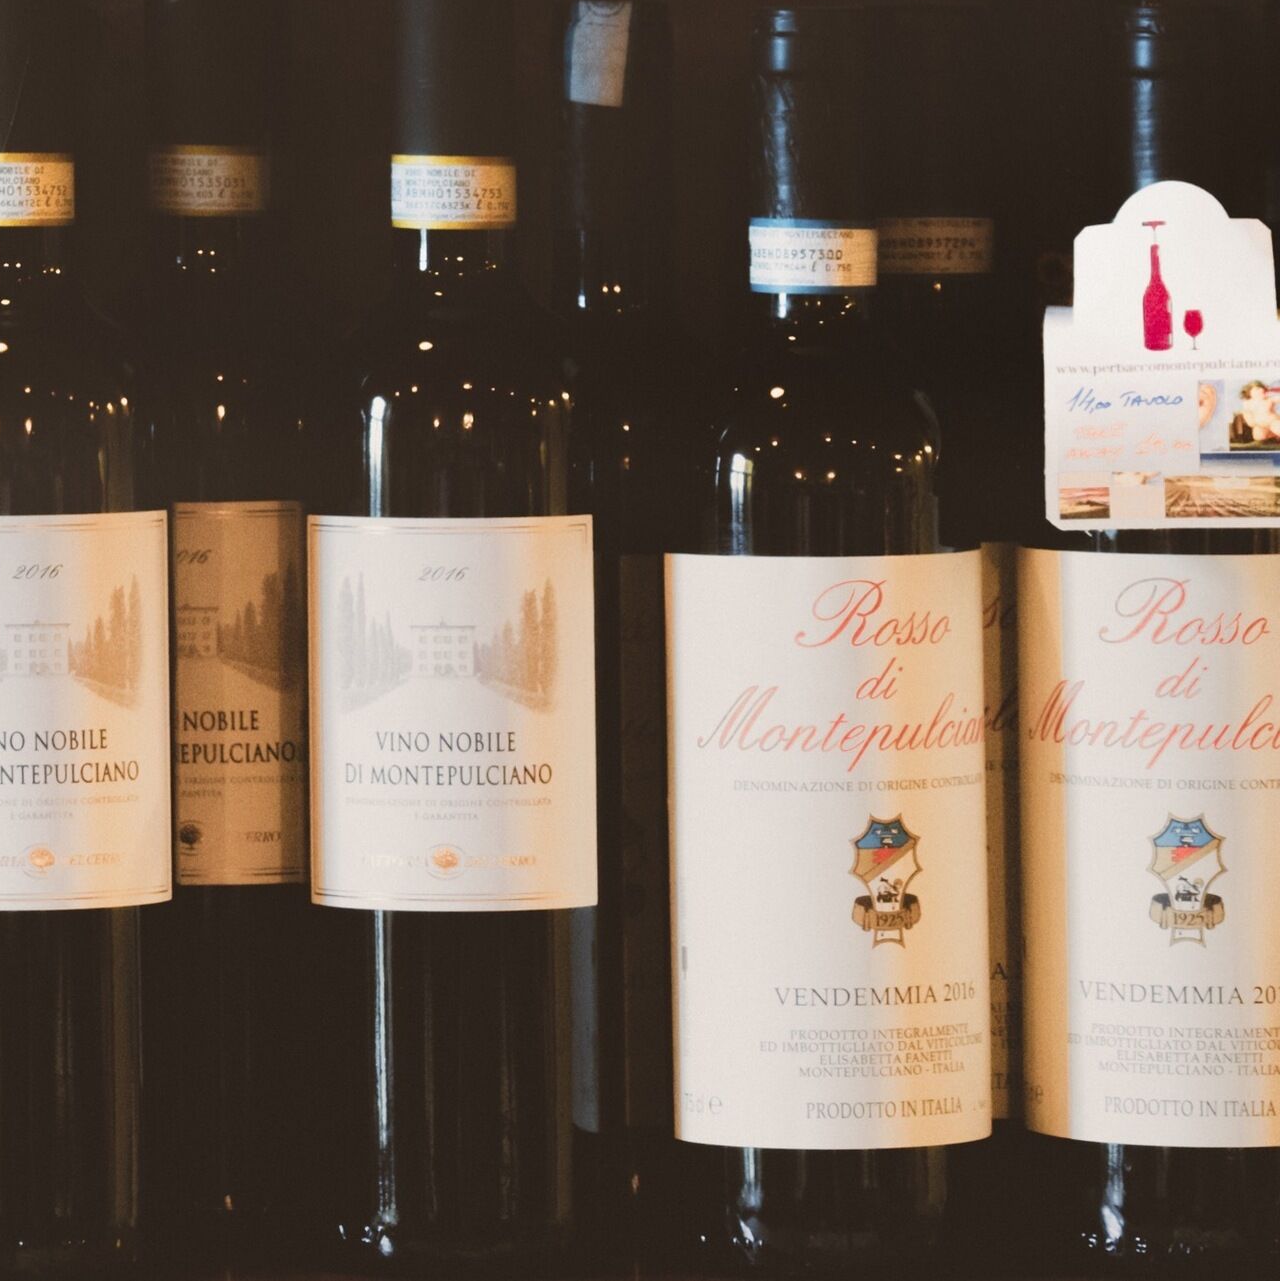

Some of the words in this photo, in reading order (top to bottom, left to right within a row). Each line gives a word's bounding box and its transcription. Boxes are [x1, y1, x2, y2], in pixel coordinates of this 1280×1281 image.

[12, 564, 64, 581] 2016
[417, 566, 470, 582] 2016
[794, 578, 952, 648] Rosso
[1098, 576, 1270, 646] Rosso
[855, 656, 904, 701] di
[1155, 655, 1208, 700] di
[182, 709, 260, 732] NOBILE
[34, 729, 109, 751] NOBILE
[375, 731, 430, 753] VINO
[438, 730, 517, 753] NOBILE
[344, 762, 364, 784] DI
[369, 762, 553, 786] MONTEPULCIANO
[1049, 772, 1154, 790] DENOMINAZIONE
[1156, 777, 1173, 790] DI
[1175, 778, 1236, 791] ORIGINE
[733, 779, 854, 793] DENOMINAZIONE
[858, 781, 873, 792] DI
[876, 778, 929, 791] ORIGINE
[773, 984, 938, 1007] VENDEMMIA
[943, 981, 976, 1003] 2016
[1079, 979, 1244, 1005] VENDEMMIA
[790, 1027, 869, 1041] PRODOTTO
[872, 1023, 970, 1039] INTEGRALMENTE
[1090, 1023, 1165, 1038] PRODOTTO
[759, 1040, 778, 1052] ED
[781, 1039, 895, 1053] IMBOTTIGLIATO
[897, 1038, 924, 1051] DAL
[1084, 1035, 1191, 1051] IMBOTTIGLIATO
[1195, 1040, 1226, 1052] DAL
[819, 1051, 901, 1066] ELISABETTA
[904, 1049, 953, 1063] FANETTI
[1116, 1049, 1200, 1063] ELISABETTA
[1203, 1052, 1263, 1063] FANETTI
[798, 1063, 923, 1078] MONTEPULCIANO
[932, 1061, 965, 1074] ITALIA
[1098, 1061, 1225, 1076] MONTEPULCIANO
[805, 1100, 897, 1120] PRODOTTO
[900, 1099, 918, 1118] IN
[920, 1097, 963, 1116] ITALIA
[1104, 1096, 1194, 1117] PRODOTTO
[1199, 1100, 1215, 1117] IN
[1224, 1100, 1277, 1117] ITALIA
